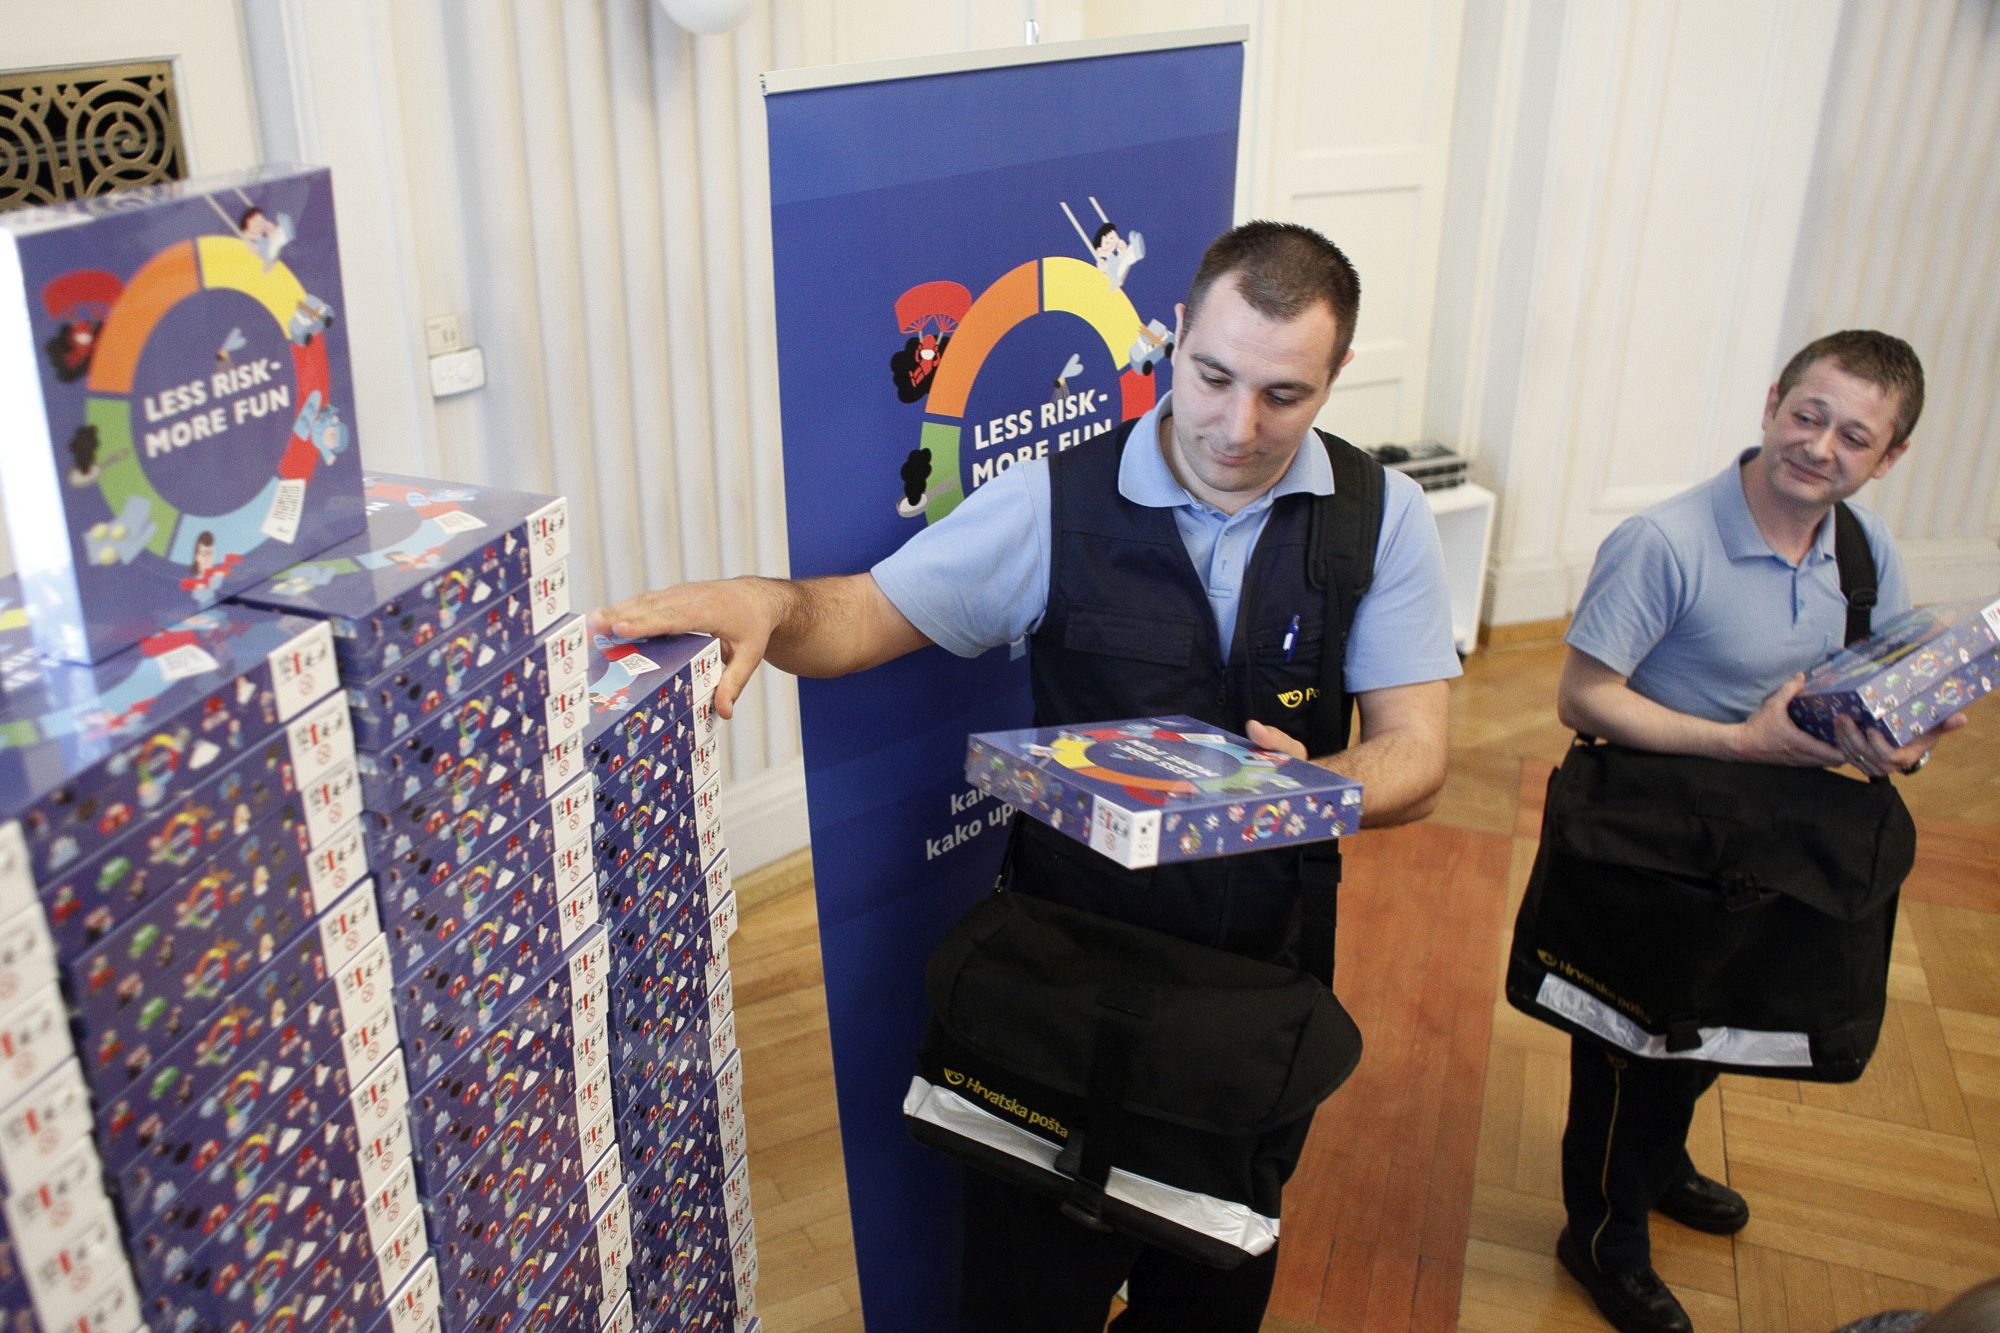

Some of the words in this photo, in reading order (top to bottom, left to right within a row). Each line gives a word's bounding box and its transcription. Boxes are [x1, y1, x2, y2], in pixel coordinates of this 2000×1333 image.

[144, 380, 208, 422] LESS
[211, 358, 282, 398] RISK-
[144, 407, 228, 458] MORE
[233, 385, 290, 425] FUN
[974, 410, 1033, 450] LESS
[950, 787, 992, 816] kak
[926, 819, 982, 860] kako
[988, 803, 1017, 826] up
[965, 1077, 1028, 1118] Hrvatska
[1028, 1111, 1069, 1138] pošta
